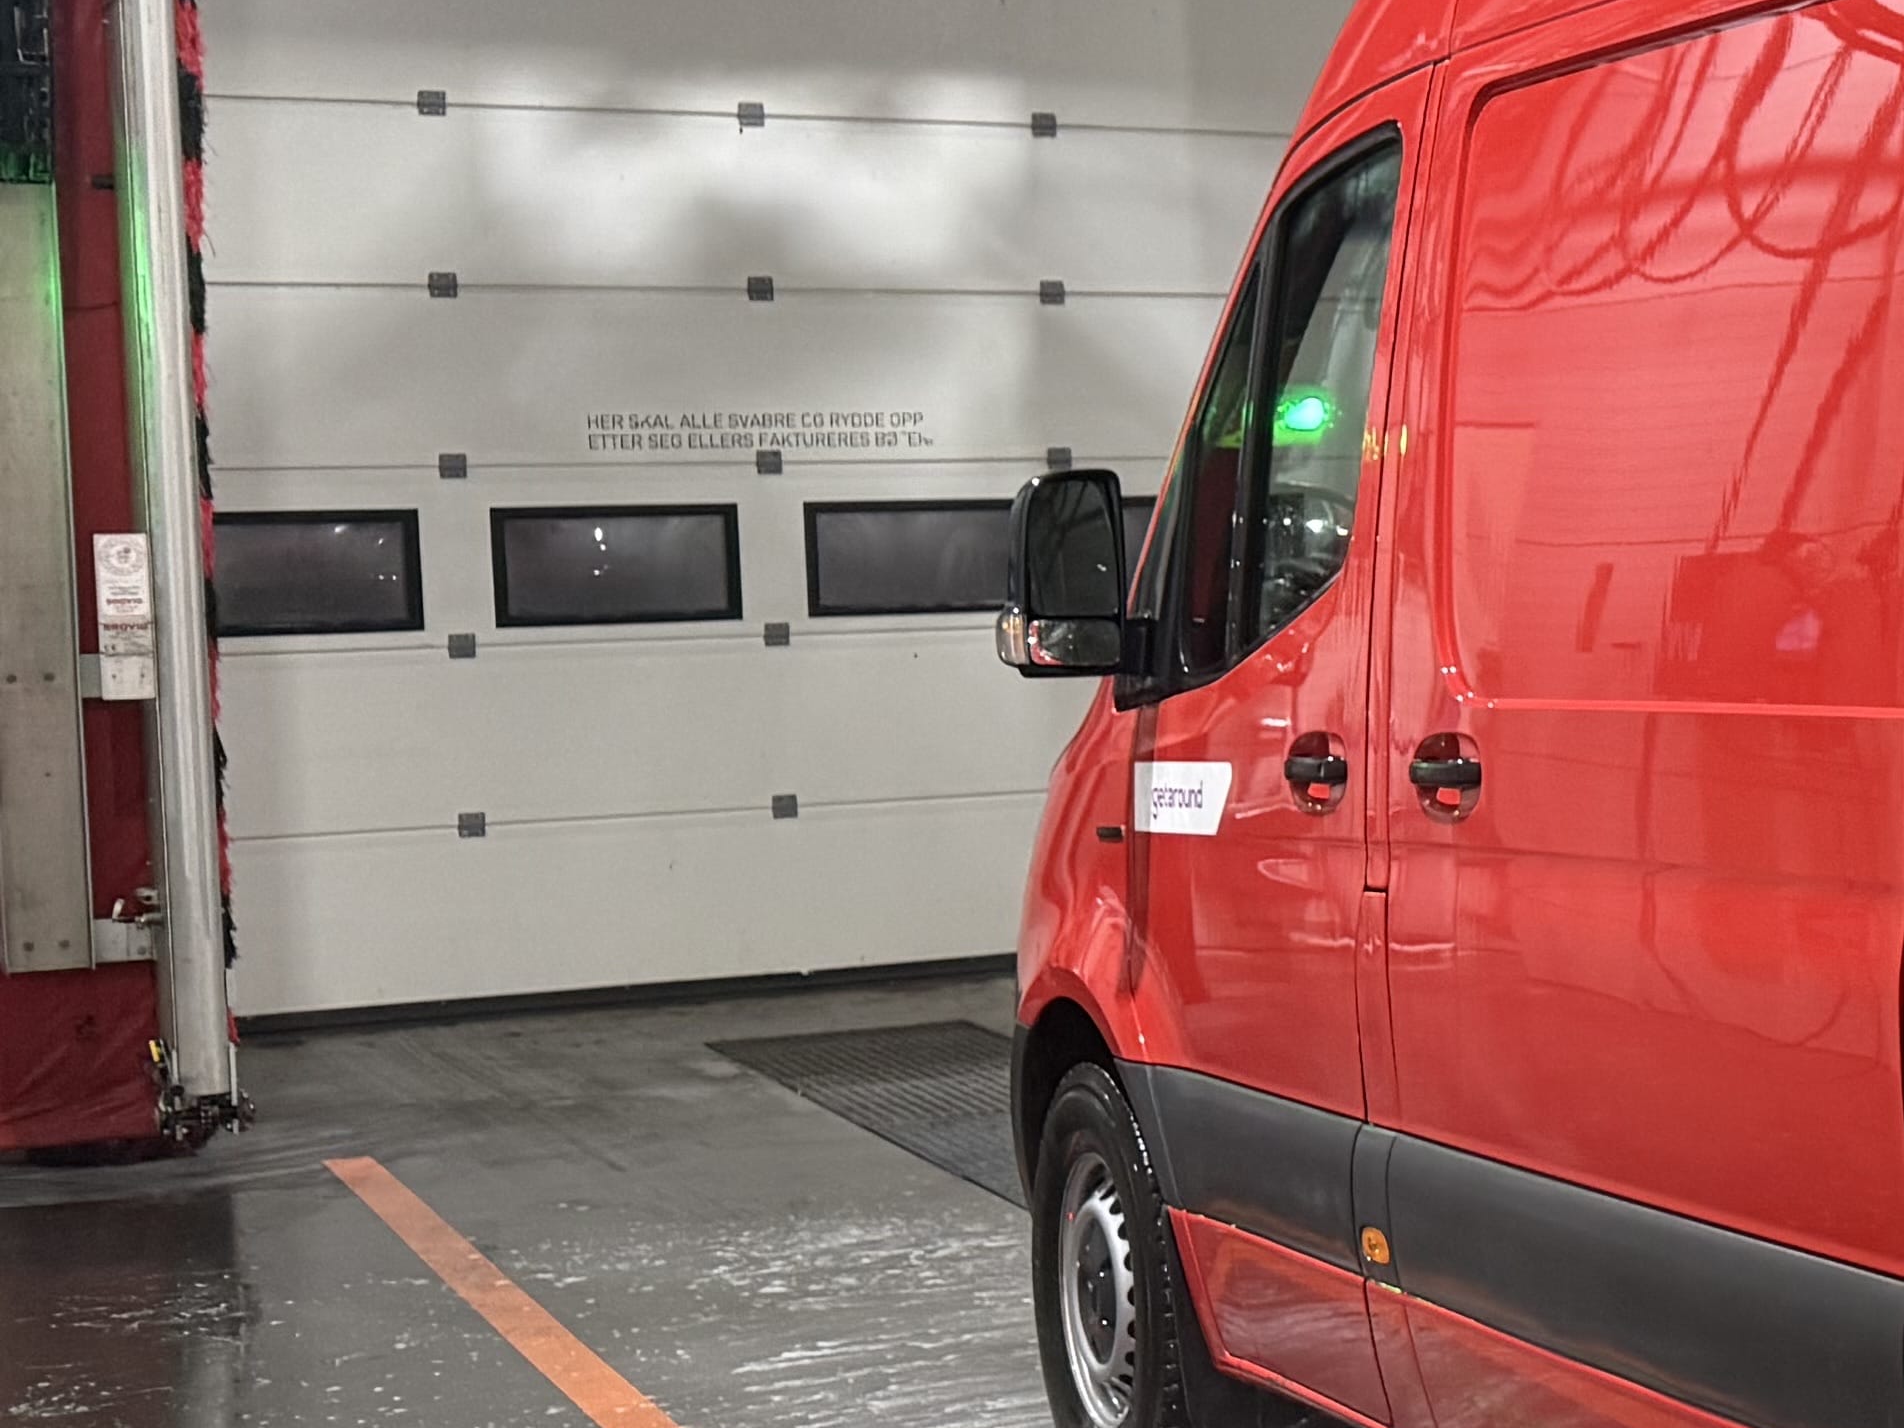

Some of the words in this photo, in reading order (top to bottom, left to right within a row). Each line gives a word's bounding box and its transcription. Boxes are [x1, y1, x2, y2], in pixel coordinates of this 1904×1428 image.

[587, 413, 624, 430] HER
[629, 413, 675, 430] SKAL
[680, 412, 723, 430] ALLE
[890, 411, 924, 428] OPP
[588, 433, 643, 450] ETTER
[688, 432, 754, 450] ELLERS
[759, 431, 870, 449] FAKTURERES
[1151, 779, 1203, 821] getaround
